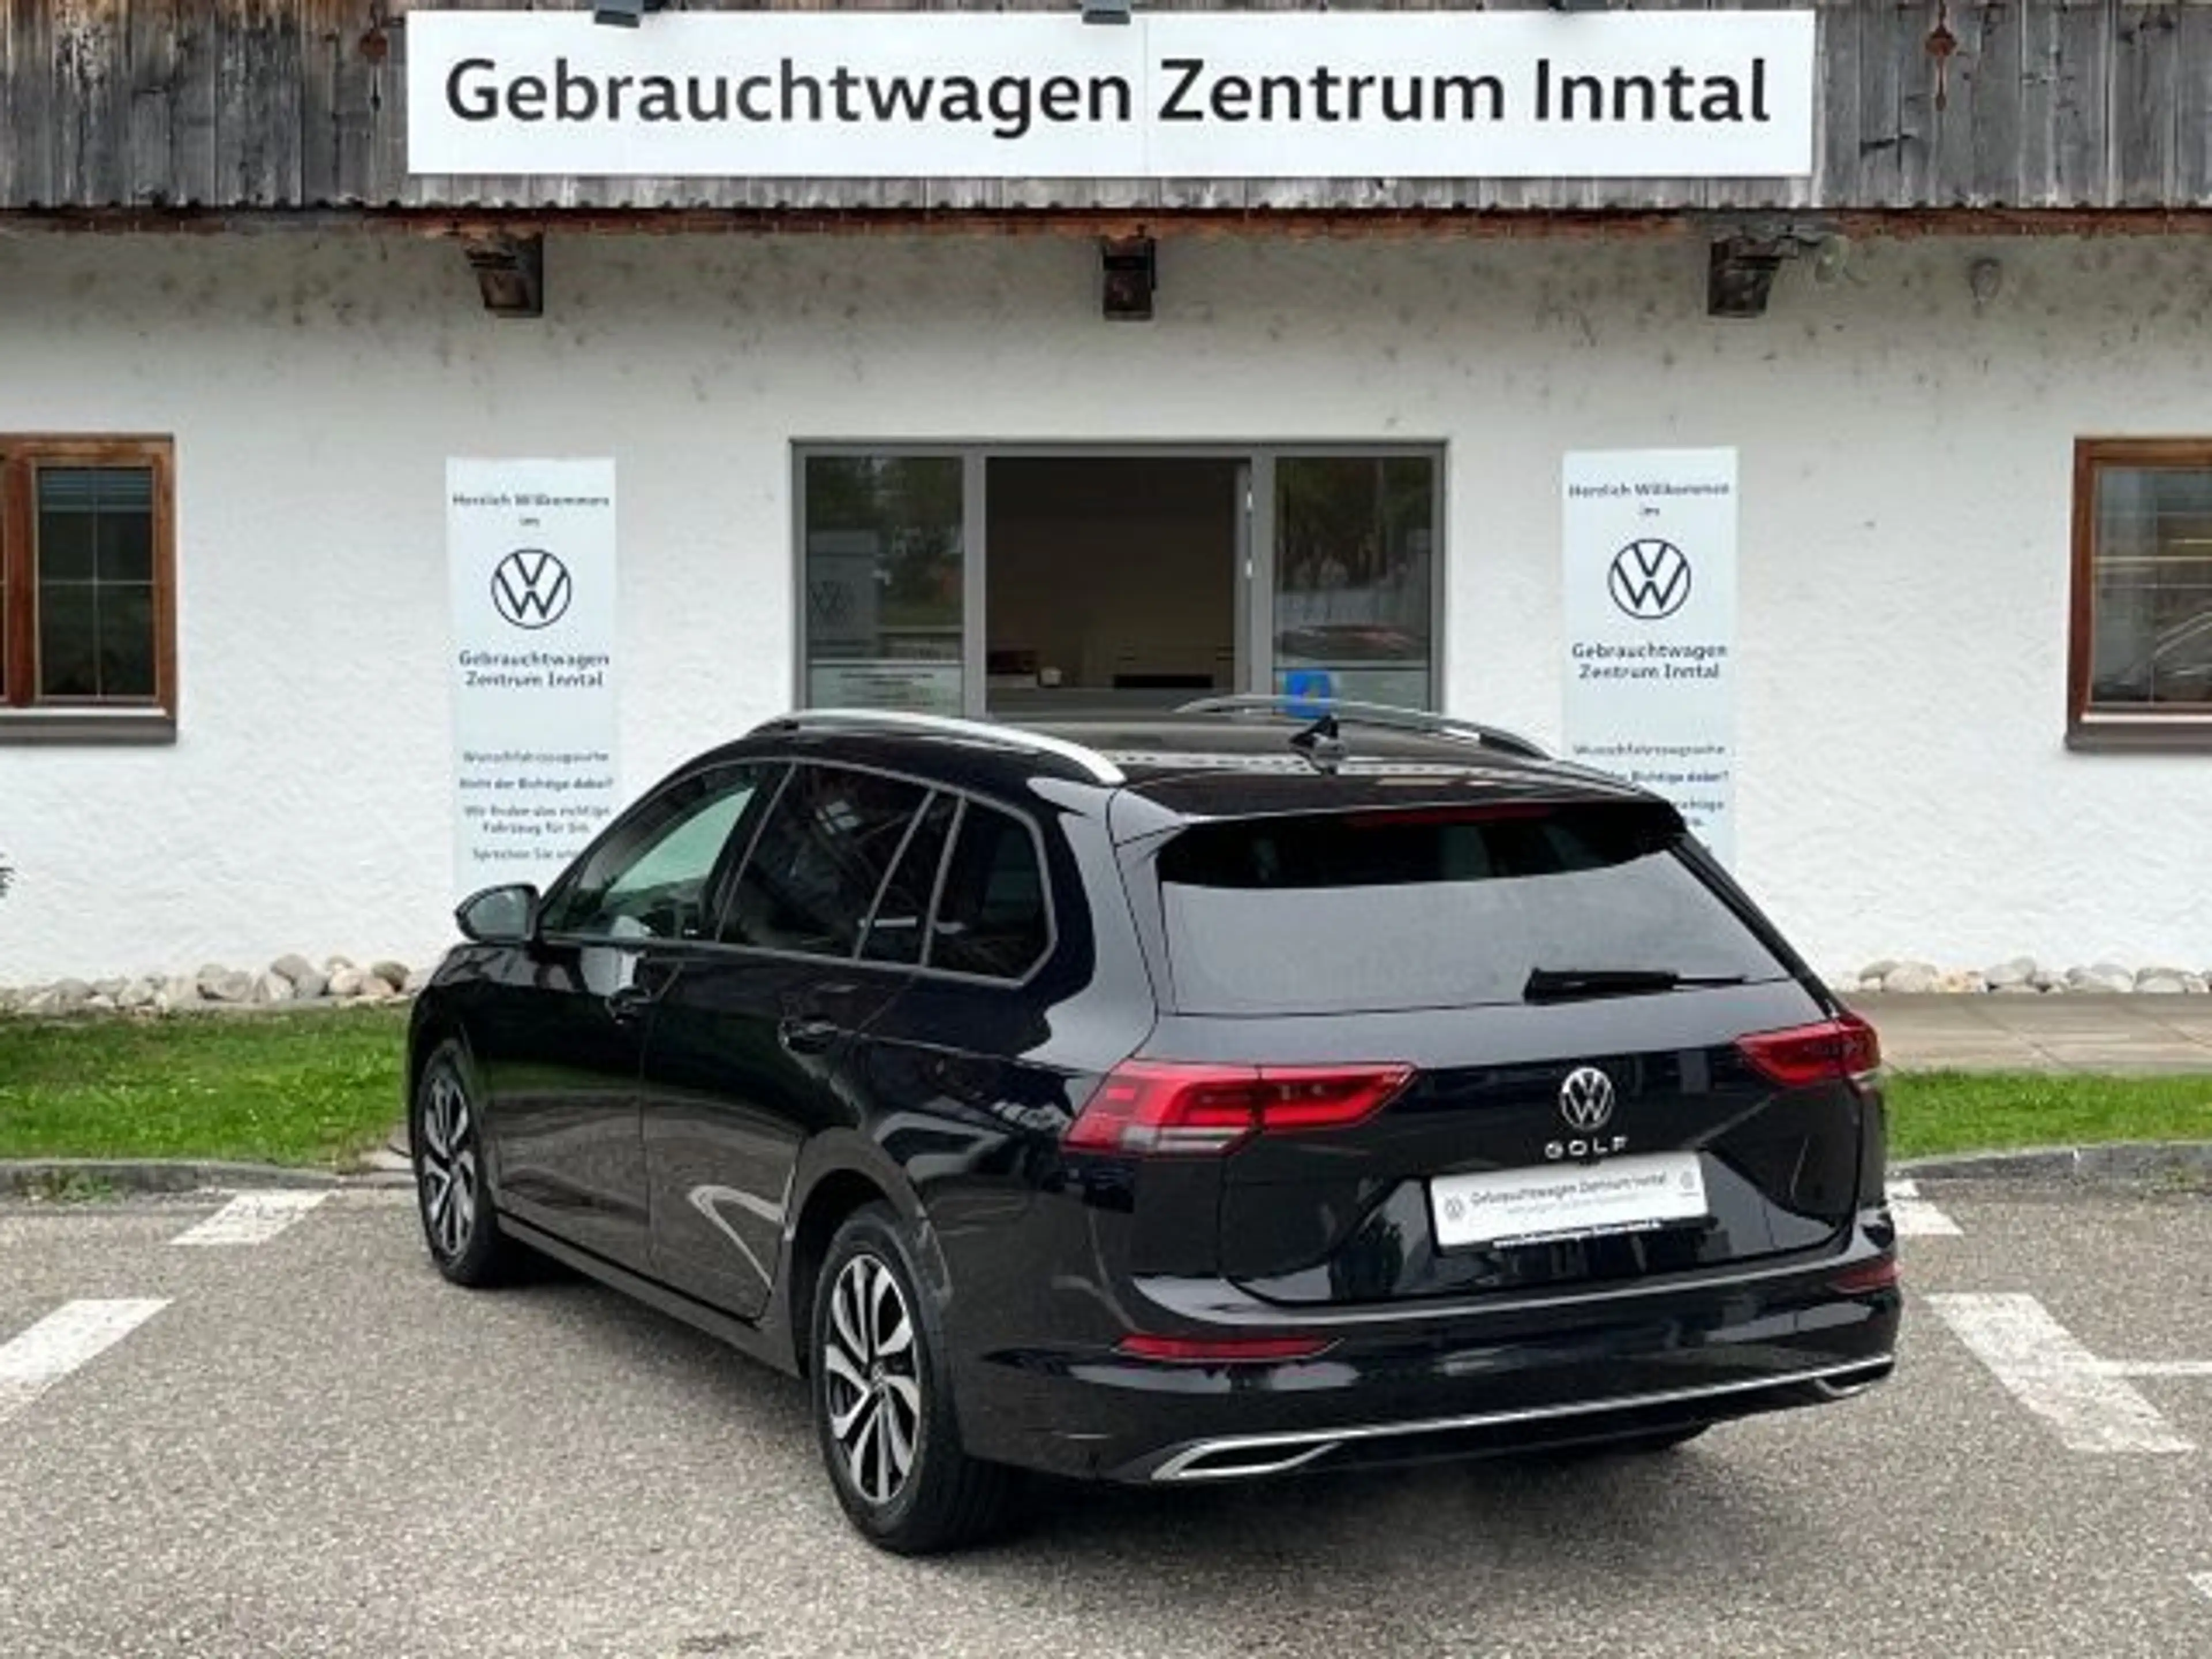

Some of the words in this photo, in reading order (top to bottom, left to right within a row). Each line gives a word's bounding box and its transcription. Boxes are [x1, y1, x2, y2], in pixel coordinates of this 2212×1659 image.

[446, 58, 1130, 139] Gebrauchtwagen
[1159, 59, 1503, 121] Zentrum
[1536, 58, 1769, 121] Inntal
[459, 650, 610, 670] Gebrauchtwagen
[1572, 642, 1728, 661] Gebrauchtwagen
[465, 670, 543, 688] Zentrum
[548, 670, 603, 688] Inntal
[1578, 664, 1660, 679] Zentrum
[1664, 662, 1719, 679] Inntal
[1544, 1135, 1630, 1160] GOLF
